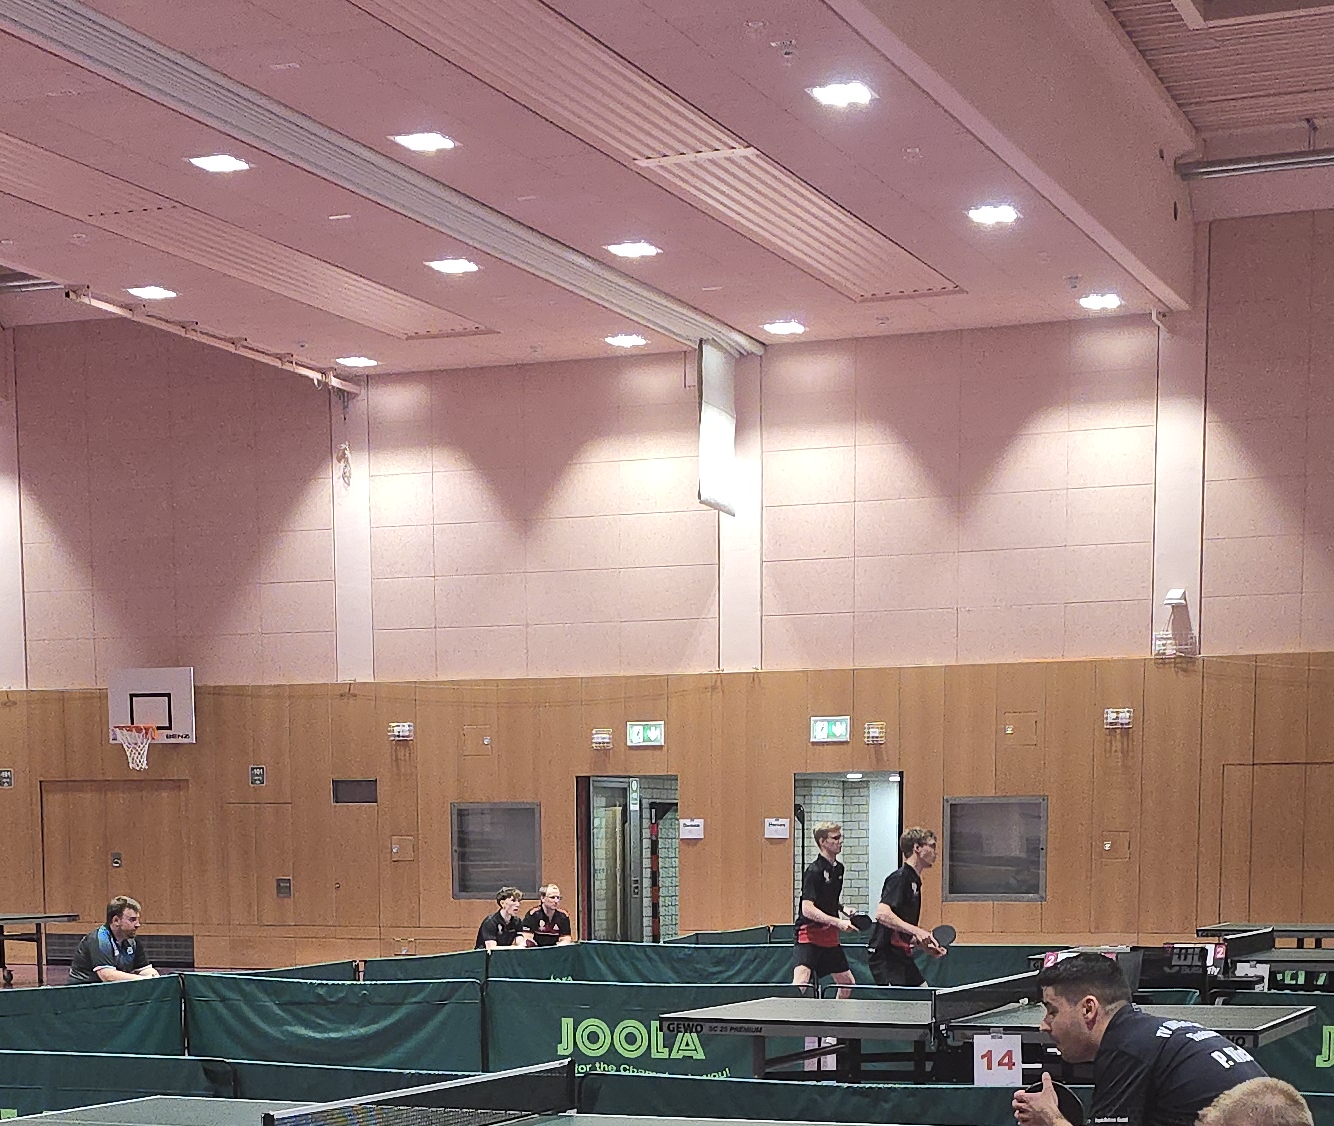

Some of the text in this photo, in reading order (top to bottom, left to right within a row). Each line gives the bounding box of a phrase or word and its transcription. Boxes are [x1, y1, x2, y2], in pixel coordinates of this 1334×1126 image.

[667, 1022, 704, 1033] GEWO
[557, 1018, 705, 1060] JOOLA
[980, 1049, 1015, 1070] 14
